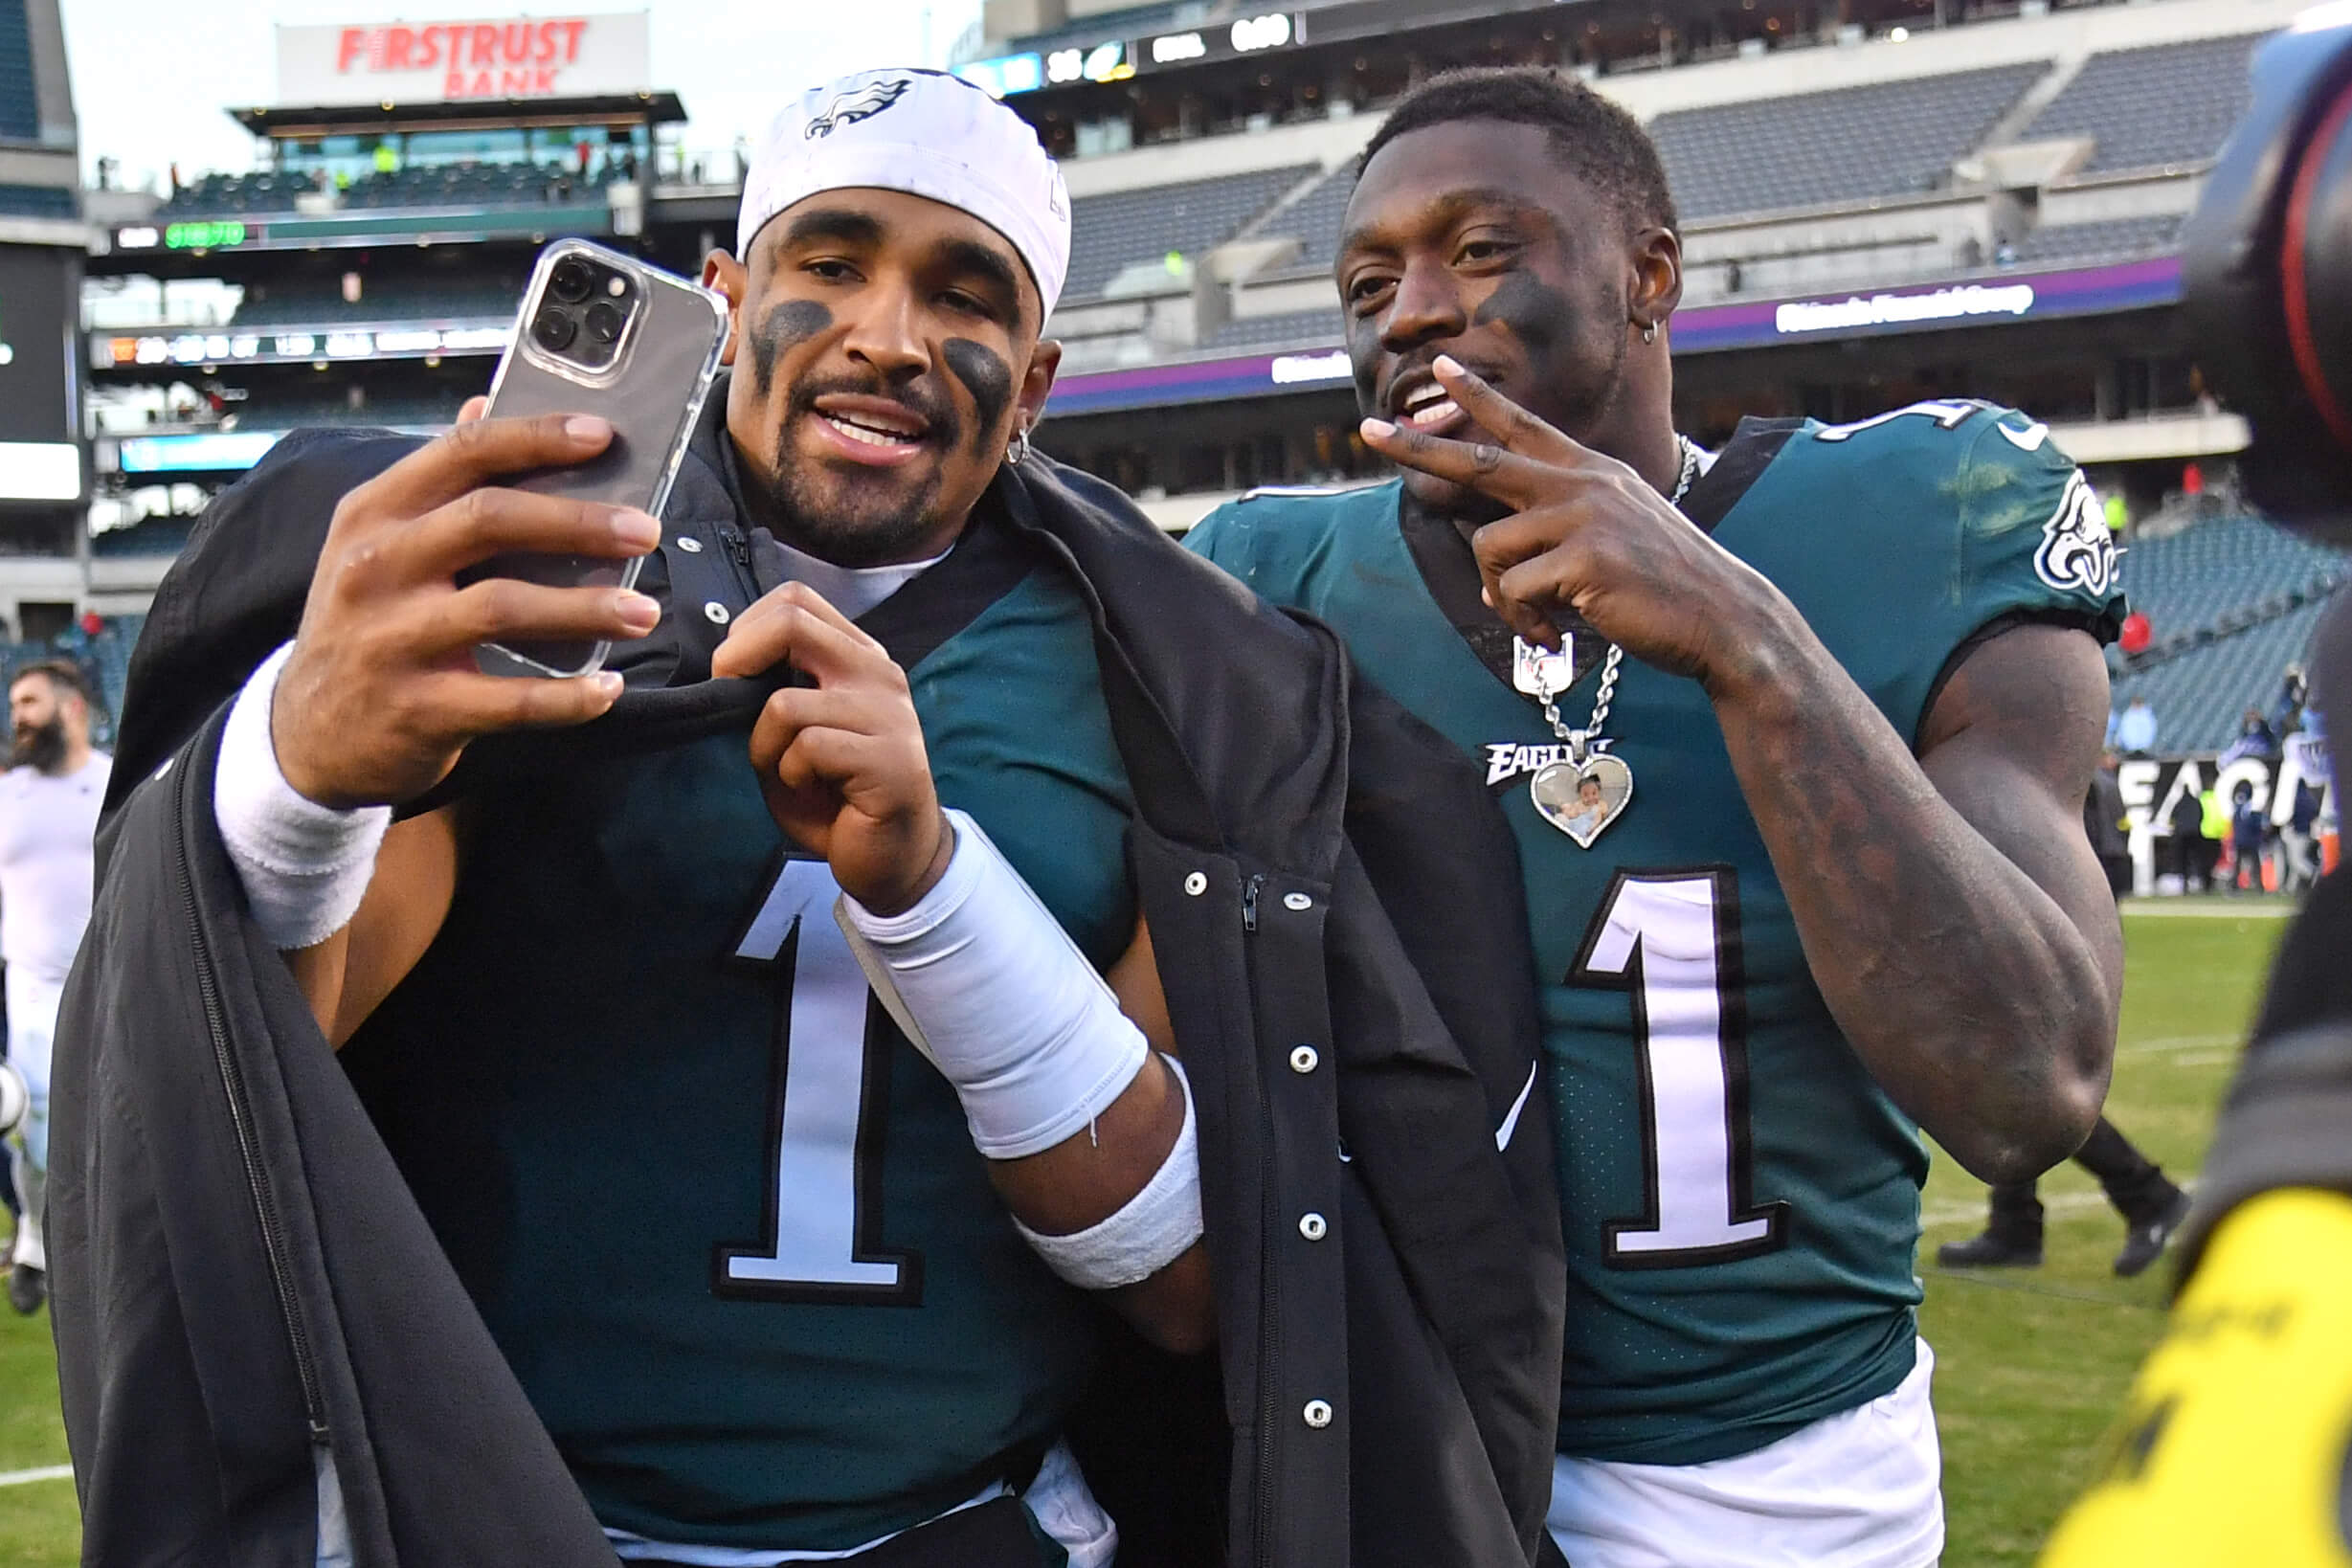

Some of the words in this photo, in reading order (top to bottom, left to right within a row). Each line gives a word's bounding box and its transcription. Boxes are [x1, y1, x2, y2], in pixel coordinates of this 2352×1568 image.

[443, 70, 560, 100] BANK
[720, 856, 906, 1290] 1
[1578, 873, 1777, 1260] 1
